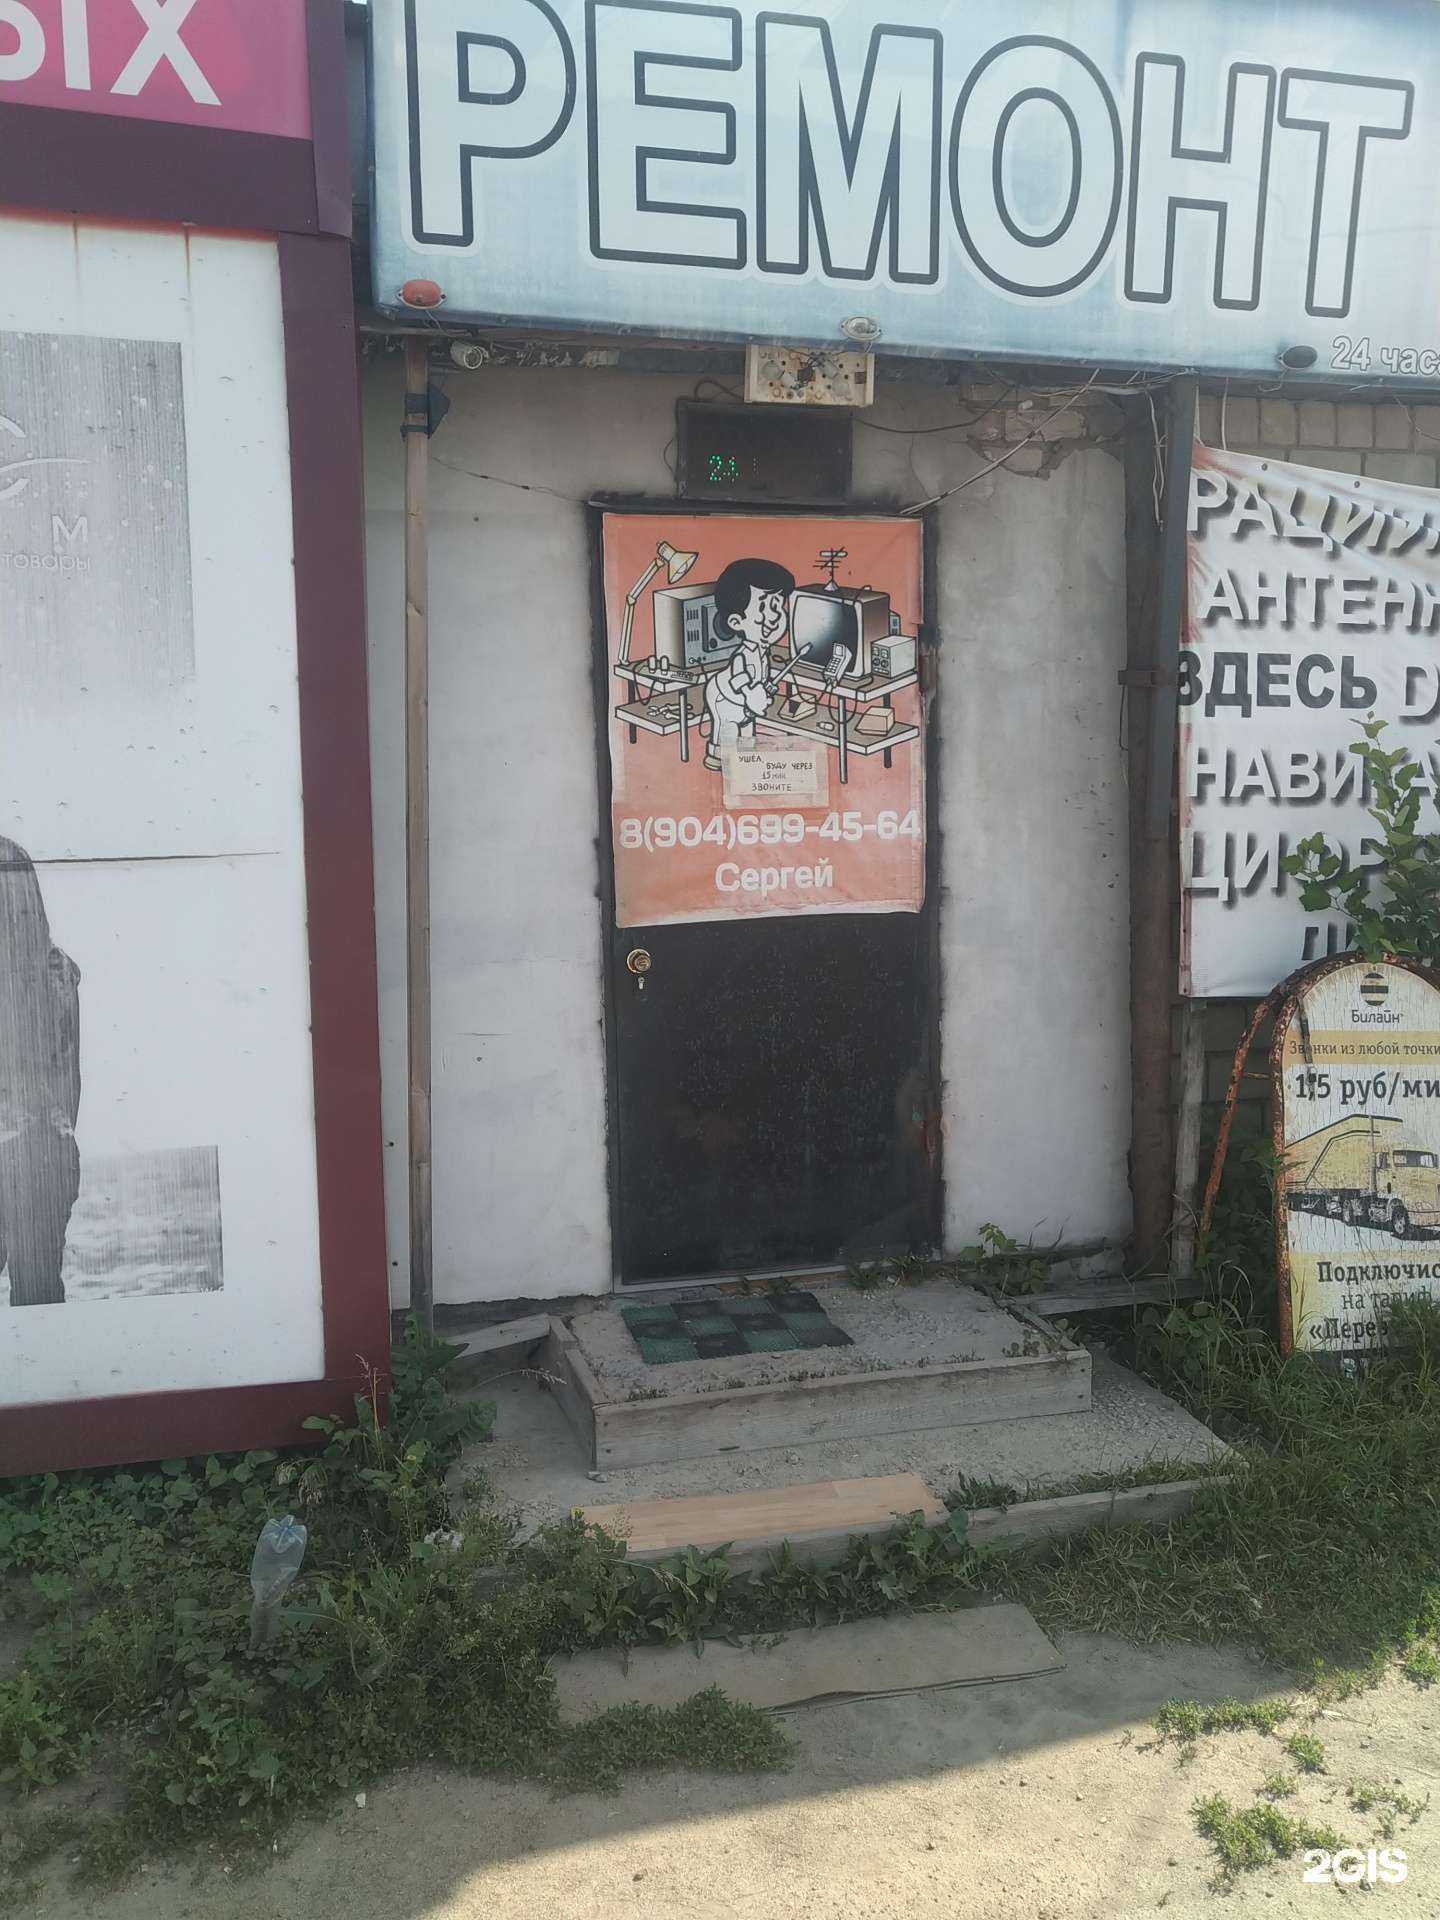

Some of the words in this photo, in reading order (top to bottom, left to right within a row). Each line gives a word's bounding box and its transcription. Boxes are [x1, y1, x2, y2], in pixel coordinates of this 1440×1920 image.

[404, 0, 1415, 318] РЕМОНТ
[1331, 335, 1371, 371] 24
[1380, 347, 1440, 376] час
[1176, 651, 1378, 718] ЗДЕСЬ
[762, 771, 771, 780] 15
[791, 762, 813, 770] ЧЕРЕЗ
[1188, 747, 1440, 800] НАВИА
[752, 783, 792, 792] ЗВОНИТЕ
[619, 809, 920, 852] 8(904)699-45-64
[715, 857, 834, 896] Сергей
[1289, 1041, 1337, 1055] Звнки
[1341, 1045, 1355, 1055] из
[1358, 1040, 1400, 1055] любой
[1342, 1294, 1366, 1310] на
